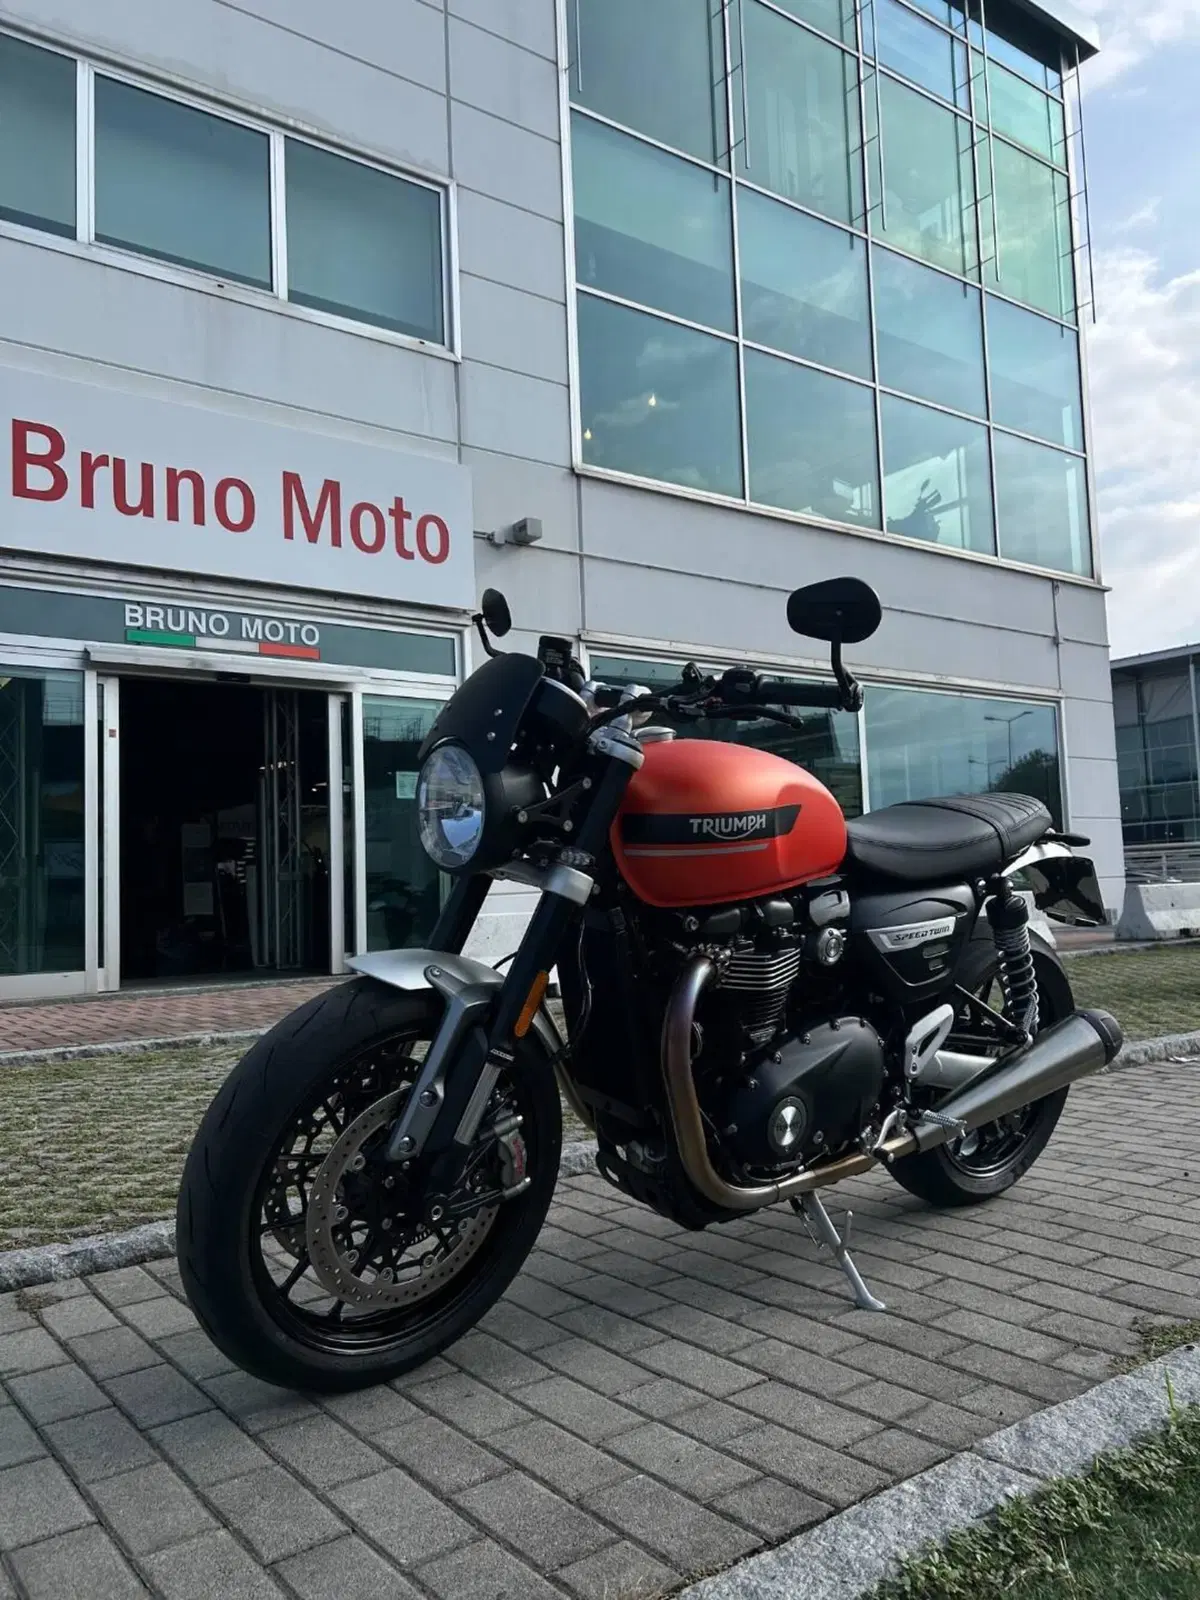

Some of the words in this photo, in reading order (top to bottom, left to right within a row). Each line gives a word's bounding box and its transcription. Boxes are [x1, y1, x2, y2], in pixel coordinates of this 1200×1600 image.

[12, 418, 255, 533] Bruno
[282, 470, 451, 564] Moto
[124, 603, 230, 636] BRUNO
[241, 617, 320, 646] MOTO
[689, 814, 767, 839] TRIUMPH
[893, 930, 928, 941] SPEED
[929, 925, 950, 936] TWIN
